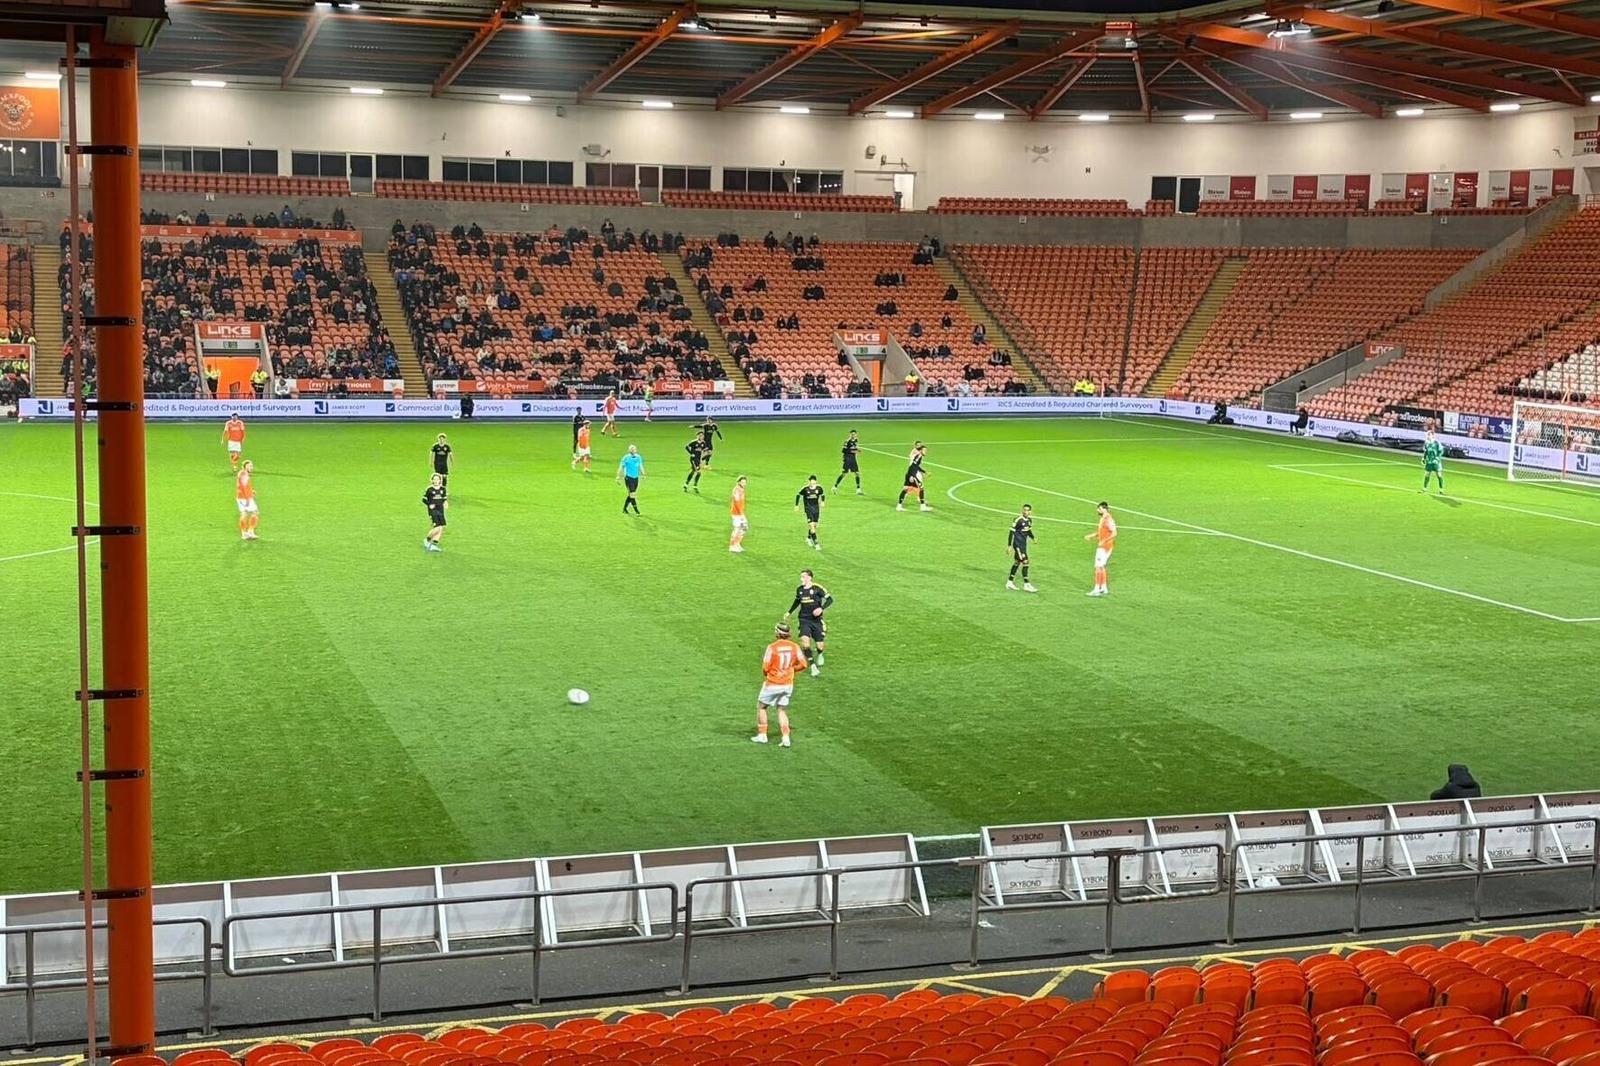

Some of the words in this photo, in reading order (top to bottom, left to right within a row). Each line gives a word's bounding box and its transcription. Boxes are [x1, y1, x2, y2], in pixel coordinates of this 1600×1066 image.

[208, 326, 251, 335] LINKS
[844, 333, 880, 342] LINKS
[144, 403, 169, 411] edited
[171, 403, 177, 411] &
[179, 403, 219, 413] Regulated
[221, 403, 261, 411] Chartered
[263, 403, 301, 413] Surveyors
[398, 404, 442, 412] Commercial
[476, 404, 504, 413] Surveys
[706, 404, 728, 412] Expert
[730, 403, 757, 411] Witness
[784, 402, 812, 411] Contract
[814, 401, 861, 410] Administration
[1054, 401, 1085, 410] Regulated
[1120, 401, 1153, 410] Surveyors
[778, 652, 792, 669] 11
[1280, 818, 1305, 827] SKYBON
[1575, 821, 1595, 829] YBOND
[1081, 829, 1112, 838] SKYBOND
[1157, 825, 1179, 833] YBOND
[1011, 833, 1044, 842] SKYBOND
[1180, 847, 1211, 855] SKYBOND
[1488, 849, 1513, 857] SKYBON
[1277, 864, 1304, 873] SKYBON
[1009, 880, 1042, 889] SKYBOND
[1083, 876, 1108, 885] KYBON
